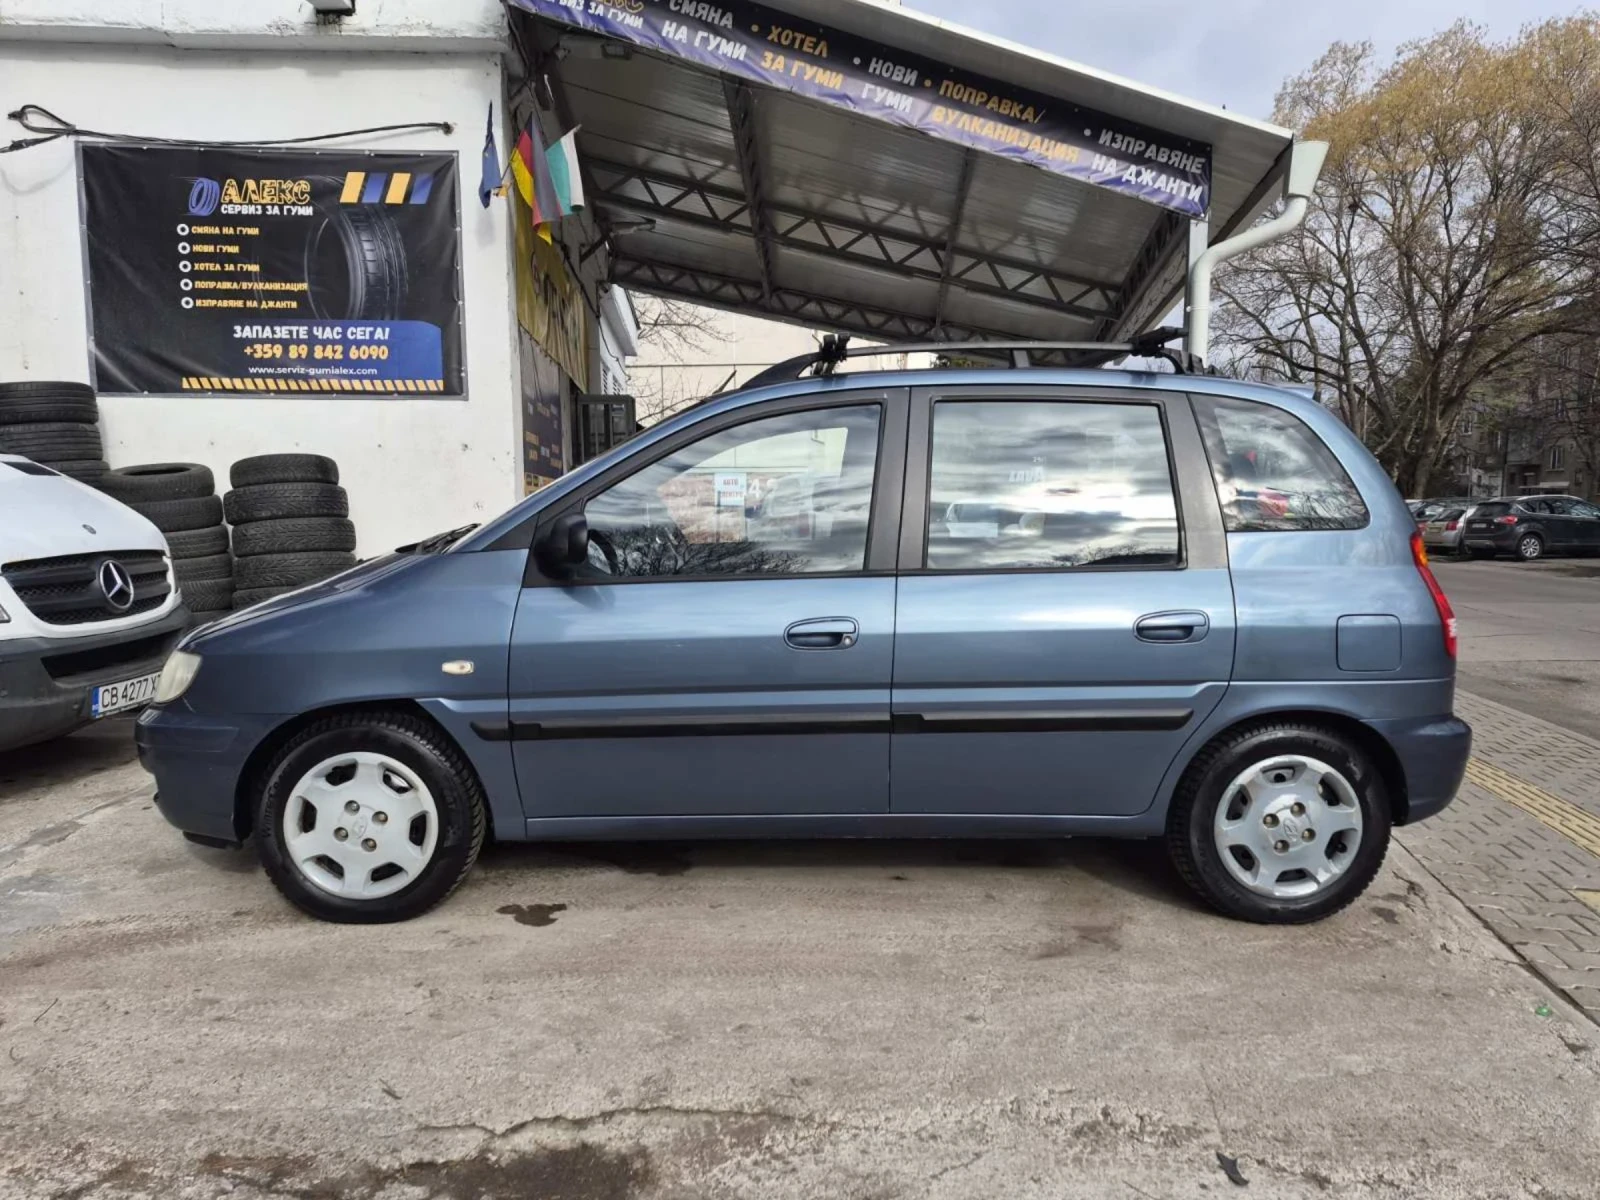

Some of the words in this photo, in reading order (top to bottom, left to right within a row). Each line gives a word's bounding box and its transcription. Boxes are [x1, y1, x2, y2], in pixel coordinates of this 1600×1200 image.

[588, 2, 604, 16] ЗА
[608, 9, 643, 28] ГУМИ
[669, 0, 733, 29] СМЯНА
[662, 20, 688, 43] НА
[694, 30, 747, 60] ГУМИ
[767, 25, 829, 58] ХОТЕЛ
[760, 51, 785, 73] ЗА
[790, 60, 845, 91] ГУМИ
[868, 57, 918, 87] НОВИ
[862, 83, 913, 112] ГУМИ
[939, 80, 1046, 123] ПОПРАВКА/
[932, 105, 1080, 162] ВУЛКАНИЗАЦИЯ
[1098, 129, 1206, 174] ИЗПРАВЯНЕ
[221, 178, 311, 204] АЛЕКС
[1091, 154, 1117, 176] НА
[1121, 164, 1203, 202] ДЖАНТИ
[221, 204, 262, 215] СЕРВИЗ
[266, 205, 281, 215] ЗА
[284, 205, 314, 216] ГУМИ
[191, 226, 220, 235] СМЯНА
[222, 227, 234, 235] НА
[236, 227, 259, 235] ГУМИ
[192, 244, 215, 253] НОВИ
[216, 245, 240, 253] ГУМИ
[193, 263, 221, 271] ХОТЕЛ
[224, 263, 235, 271] ЗА
[237, 264, 260, 272] ГУМИ
[195, 299, 244, 308] ИЗПРАВЯНЕ
[246, 300, 258, 308] НА
[261, 300, 297, 310] ДЖАНТИ
[233, 325, 308, 339] ЗАПАЗЕТЕ
[313, 326, 342, 340] ЧАС
[346, 327, 390, 340] СЕГА!
[244, 343, 283, 359] +359
[288, 344, 308, 359] 89
[313, 345, 343, 359] 842
[349, 345, 389, 360] 6090
[248, 366, 378, 376] www.serviz-gumialex.com
[101, 686, 119, 708] CB
[121, 678, 149, 703] 4277
[150, 673, 161, 695] X
